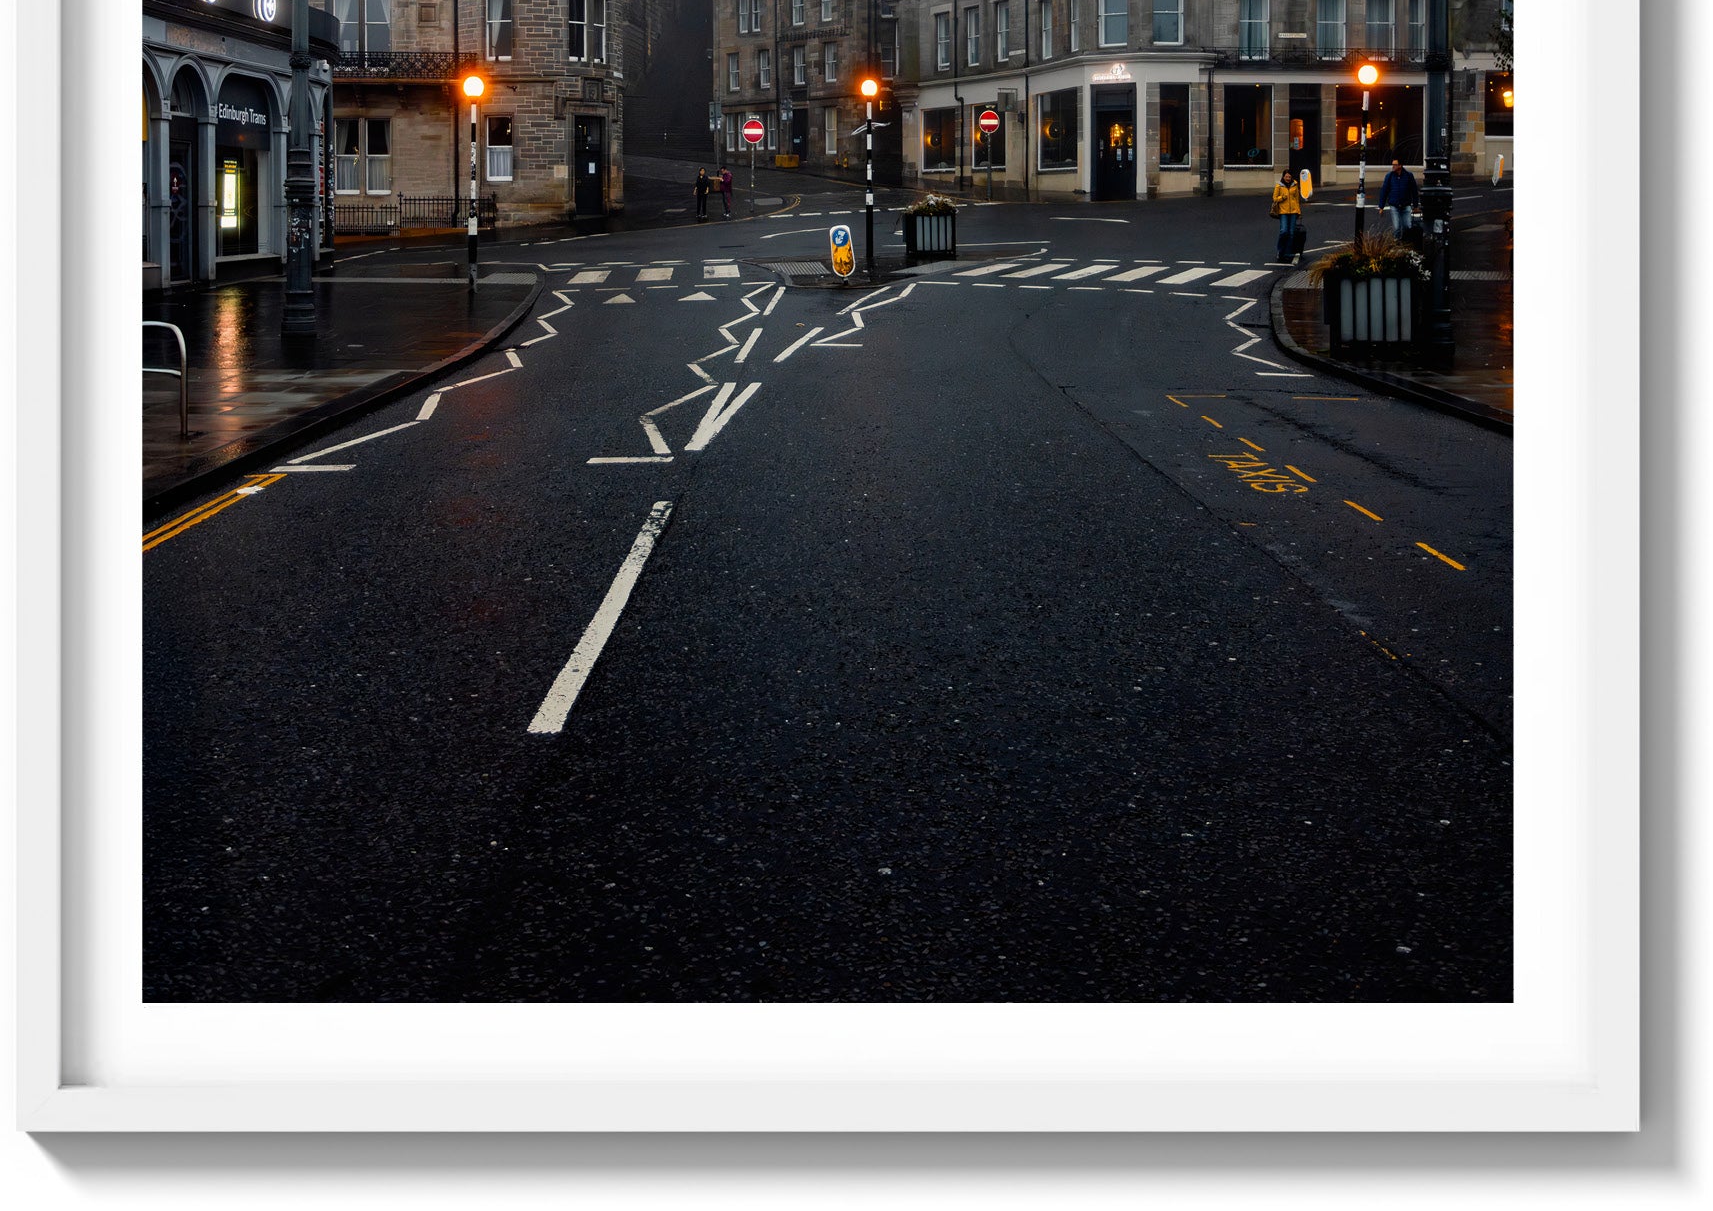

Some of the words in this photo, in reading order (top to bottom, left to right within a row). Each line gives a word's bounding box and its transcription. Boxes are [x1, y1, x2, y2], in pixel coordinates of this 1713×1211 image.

[218, 102, 249, 125] Edinburgh
[249, 108, 266, 125] Trams
[1208, 451, 1309, 493] TAXIS
